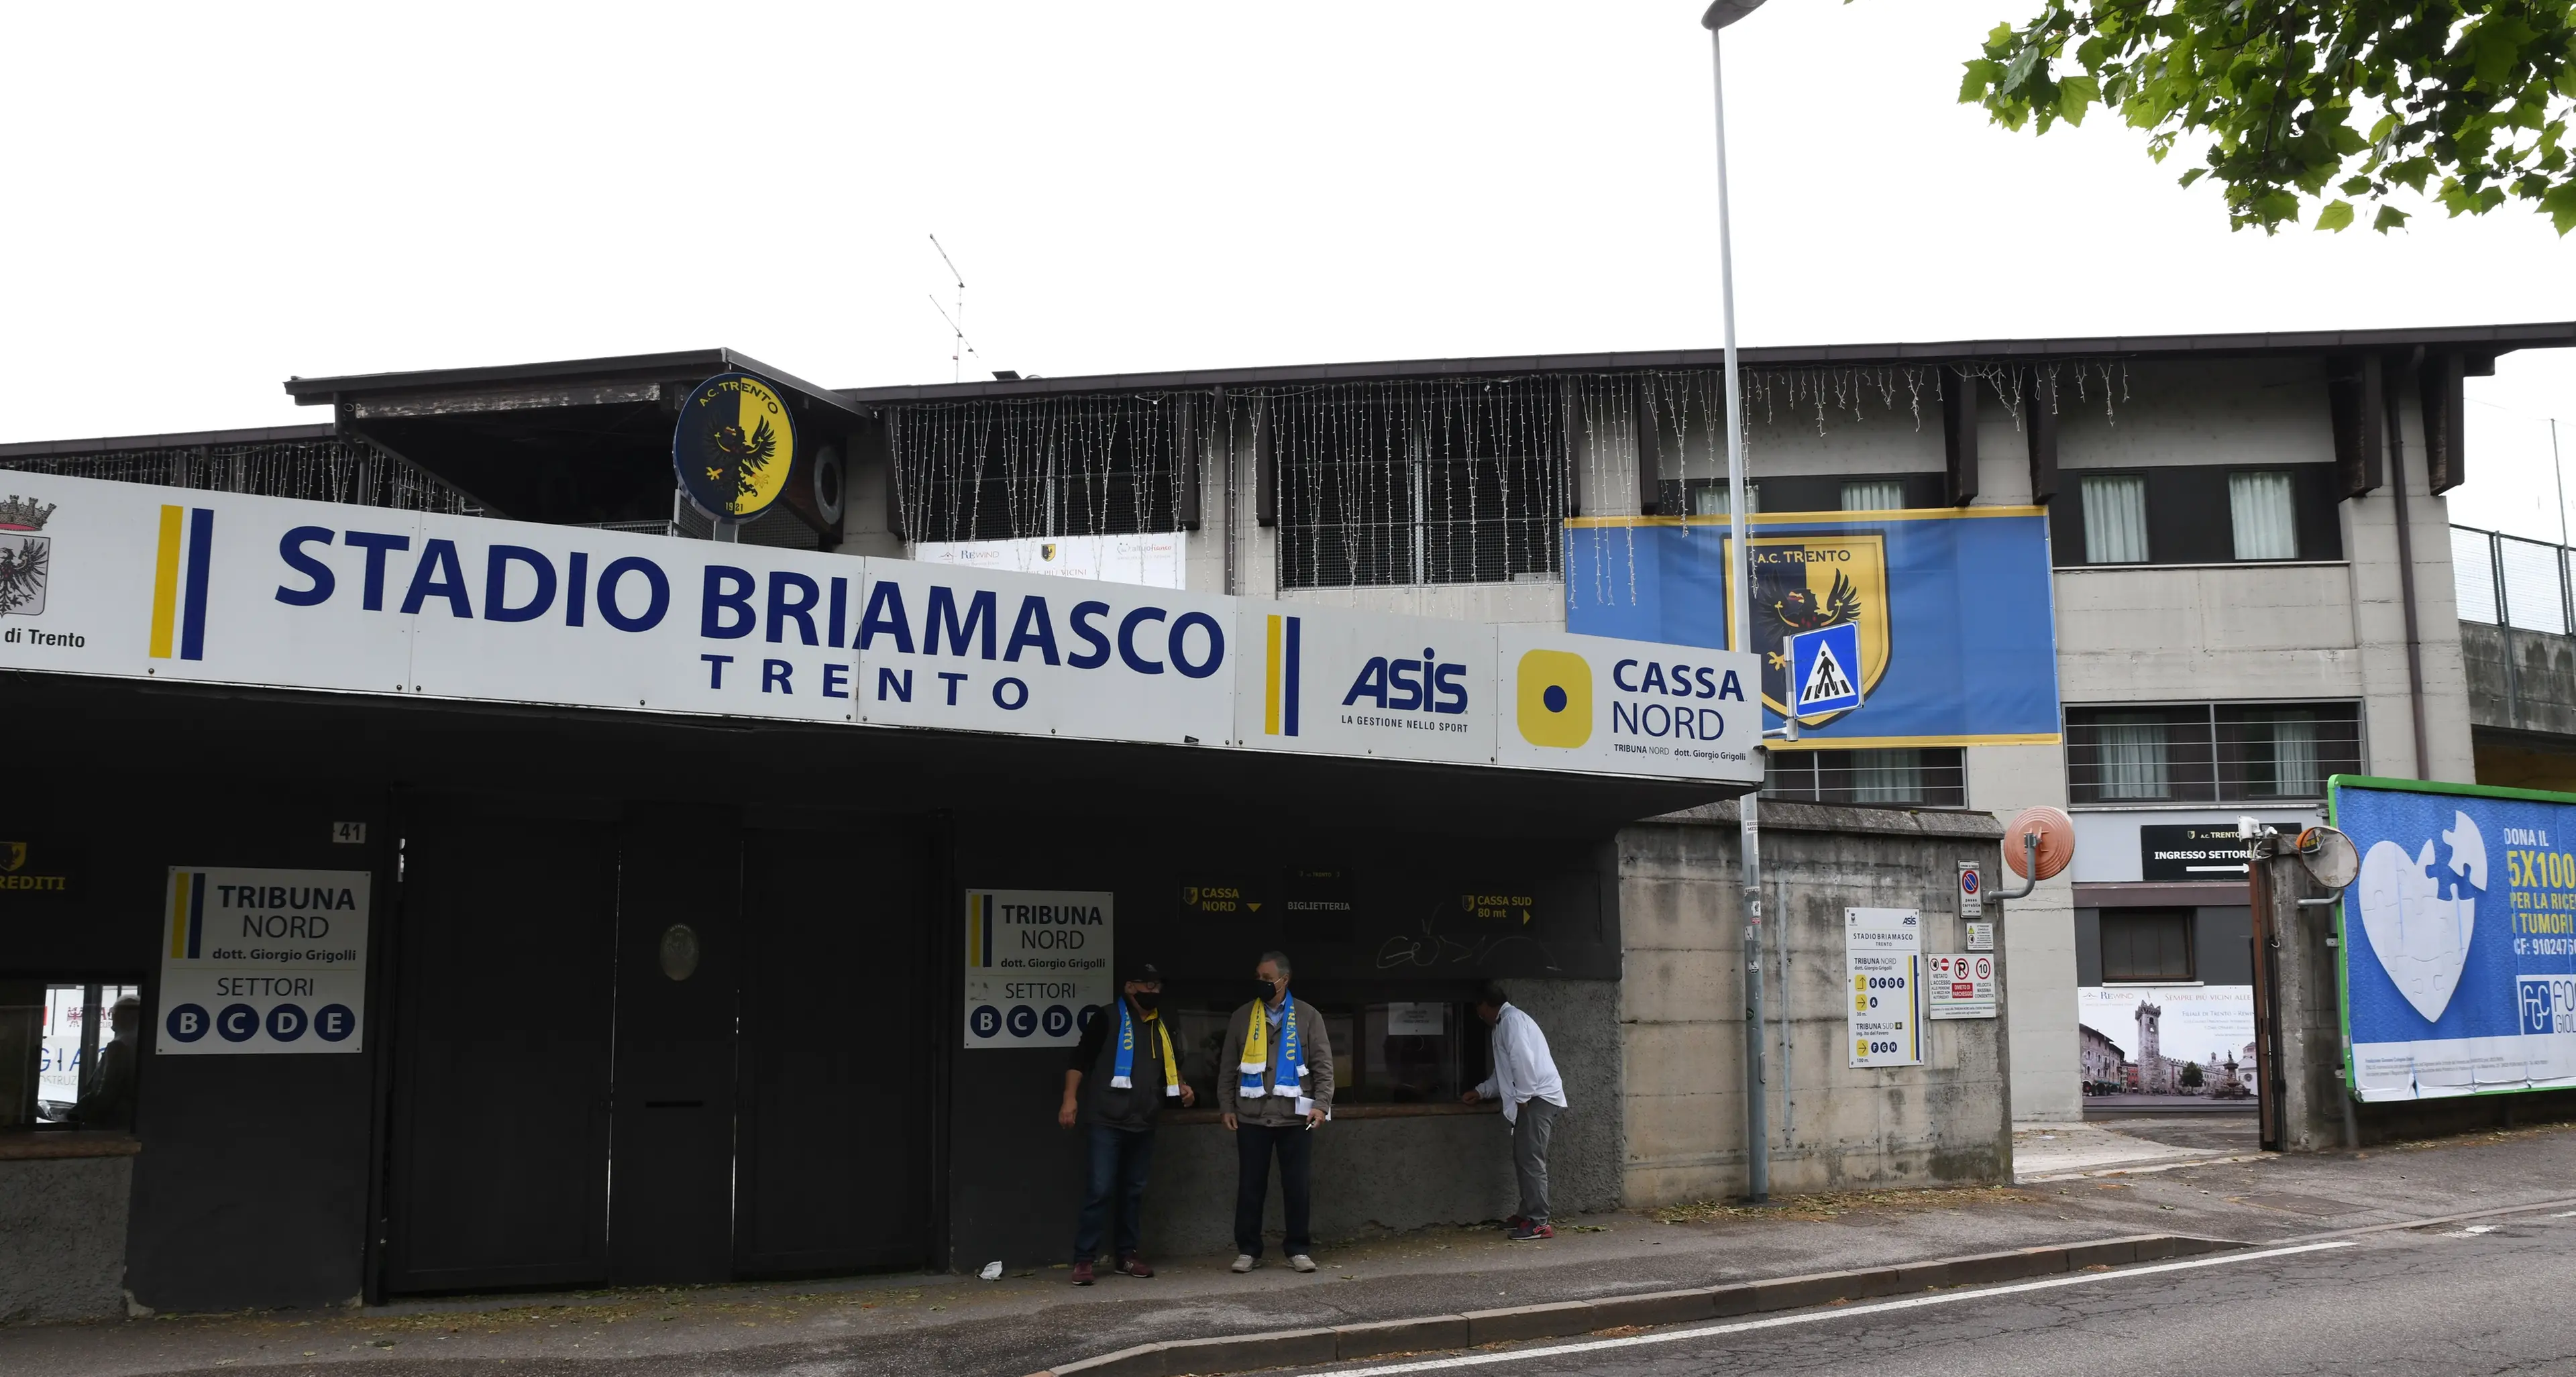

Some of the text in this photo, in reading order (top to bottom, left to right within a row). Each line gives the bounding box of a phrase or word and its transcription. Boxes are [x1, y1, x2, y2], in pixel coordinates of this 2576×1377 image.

[699, 381, 778, 415] A.C. TRENTO
[724, 502, 743, 512] 1921
[1757, 550, 1851, 563] A.C. TRENTO
[275, 526, 1225, 679] STADIO BRIAMASCO
[5, 628, 85, 648] di Trento
[701, 654, 1028, 711] TRENTO
[1613, 659, 1746, 702] CASSA
[1342, 715, 1468, 733] LA GESTIONE NELLO SPORT
[1613, 701, 1724, 740] NORD
[1614, 744, 1746, 762] TRIBUNA NORD dott. Giorgio Grigolli
[339, 824, 360, 841] 41
[2504, 828, 2549, 847] DONA IL
[2154, 850, 2206, 860] INGRESSO
[217, 885, 356, 911] TRIBUNA
[1201, 887, 1240, 899] CASSA
[1477, 895, 1532, 905] CASSA SUD
[2510, 892, 2576, 910] PER LA RICE
[1002, 905, 1104, 925] TRIBUNA
[1202, 901, 1236, 912] NORD
[1287, 901, 1350, 911] BIGLIETTERIA
[1478, 908, 1507, 918] 80 mt
[243, 915, 329, 939] NORD
[2519, 913, 2573, 934] TUMORI
[1022, 930, 1085, 949] NORD
[2514, 938, 2530, 955] CF:
[213, 948, 357, 963] dott. Giorgio Grigolli
[1001, 958, 1106, 970] dott. Giorgio Grigolli
[1854, 957, 1896, 965] TRIBUNA NORD
[1979, 964, 1988, 974] 10
[217, 978, 314, 997] SETTORI
[1006, 983, 1075, 999] SETTORI
[2553, 980, 2576, 1011] FO
[180, 1012, 342, 1034] B C D E
[980, 1013, 994, 1030] B
[1014, 1012, 1028, 1030] C
[1051, 1012, 1065, 1030] D
